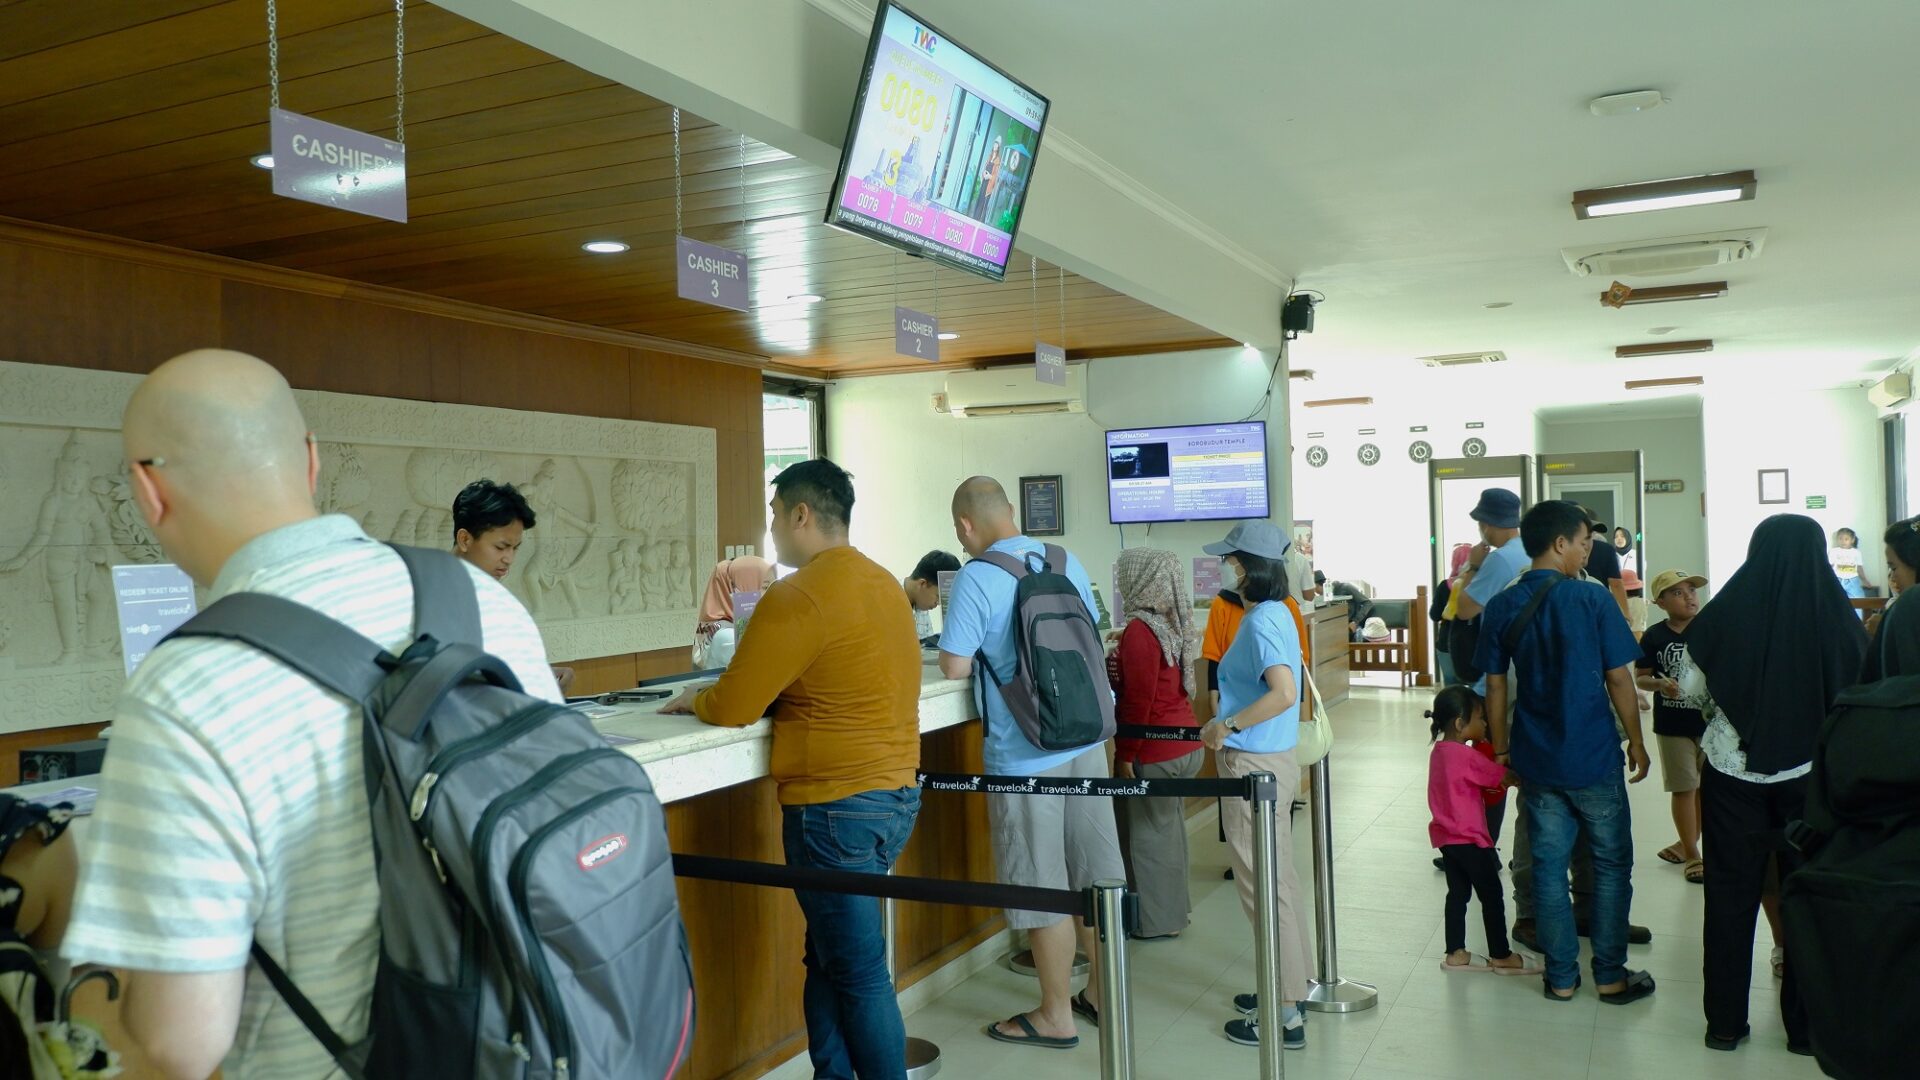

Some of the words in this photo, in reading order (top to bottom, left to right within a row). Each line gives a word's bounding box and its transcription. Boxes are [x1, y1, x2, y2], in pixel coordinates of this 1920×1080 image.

[913, 26, 937, 53] TWC
[880, 73, 937, 132] 0080
[292, 134, 389, 171] CASHIER
[857, 193, 879, 212] 0078
[904, 211, 924, 229] 0079
[688, 253, 739, 280] CASHIER
[711, 279, 719, 298] 3
[902, 318, 934, 338] CASHIER
[916, 338, 921, 353] 2
[1040, 352, 1063, 366] CASHIER
[1050, 369, 1054, 380] 1
[1188, 439, 1223, 447] BOROBUDUR
[120, 588, 146, 596] REDEEM
[1145, 731, 1183, 740] traveloka
[932, 780, 977, 791] traveloka
[987, 782, 1033, 793] traveloka
[1040, 783, 1088, 795] traveloka
[1098, 785, 1146, 796] traveloka
